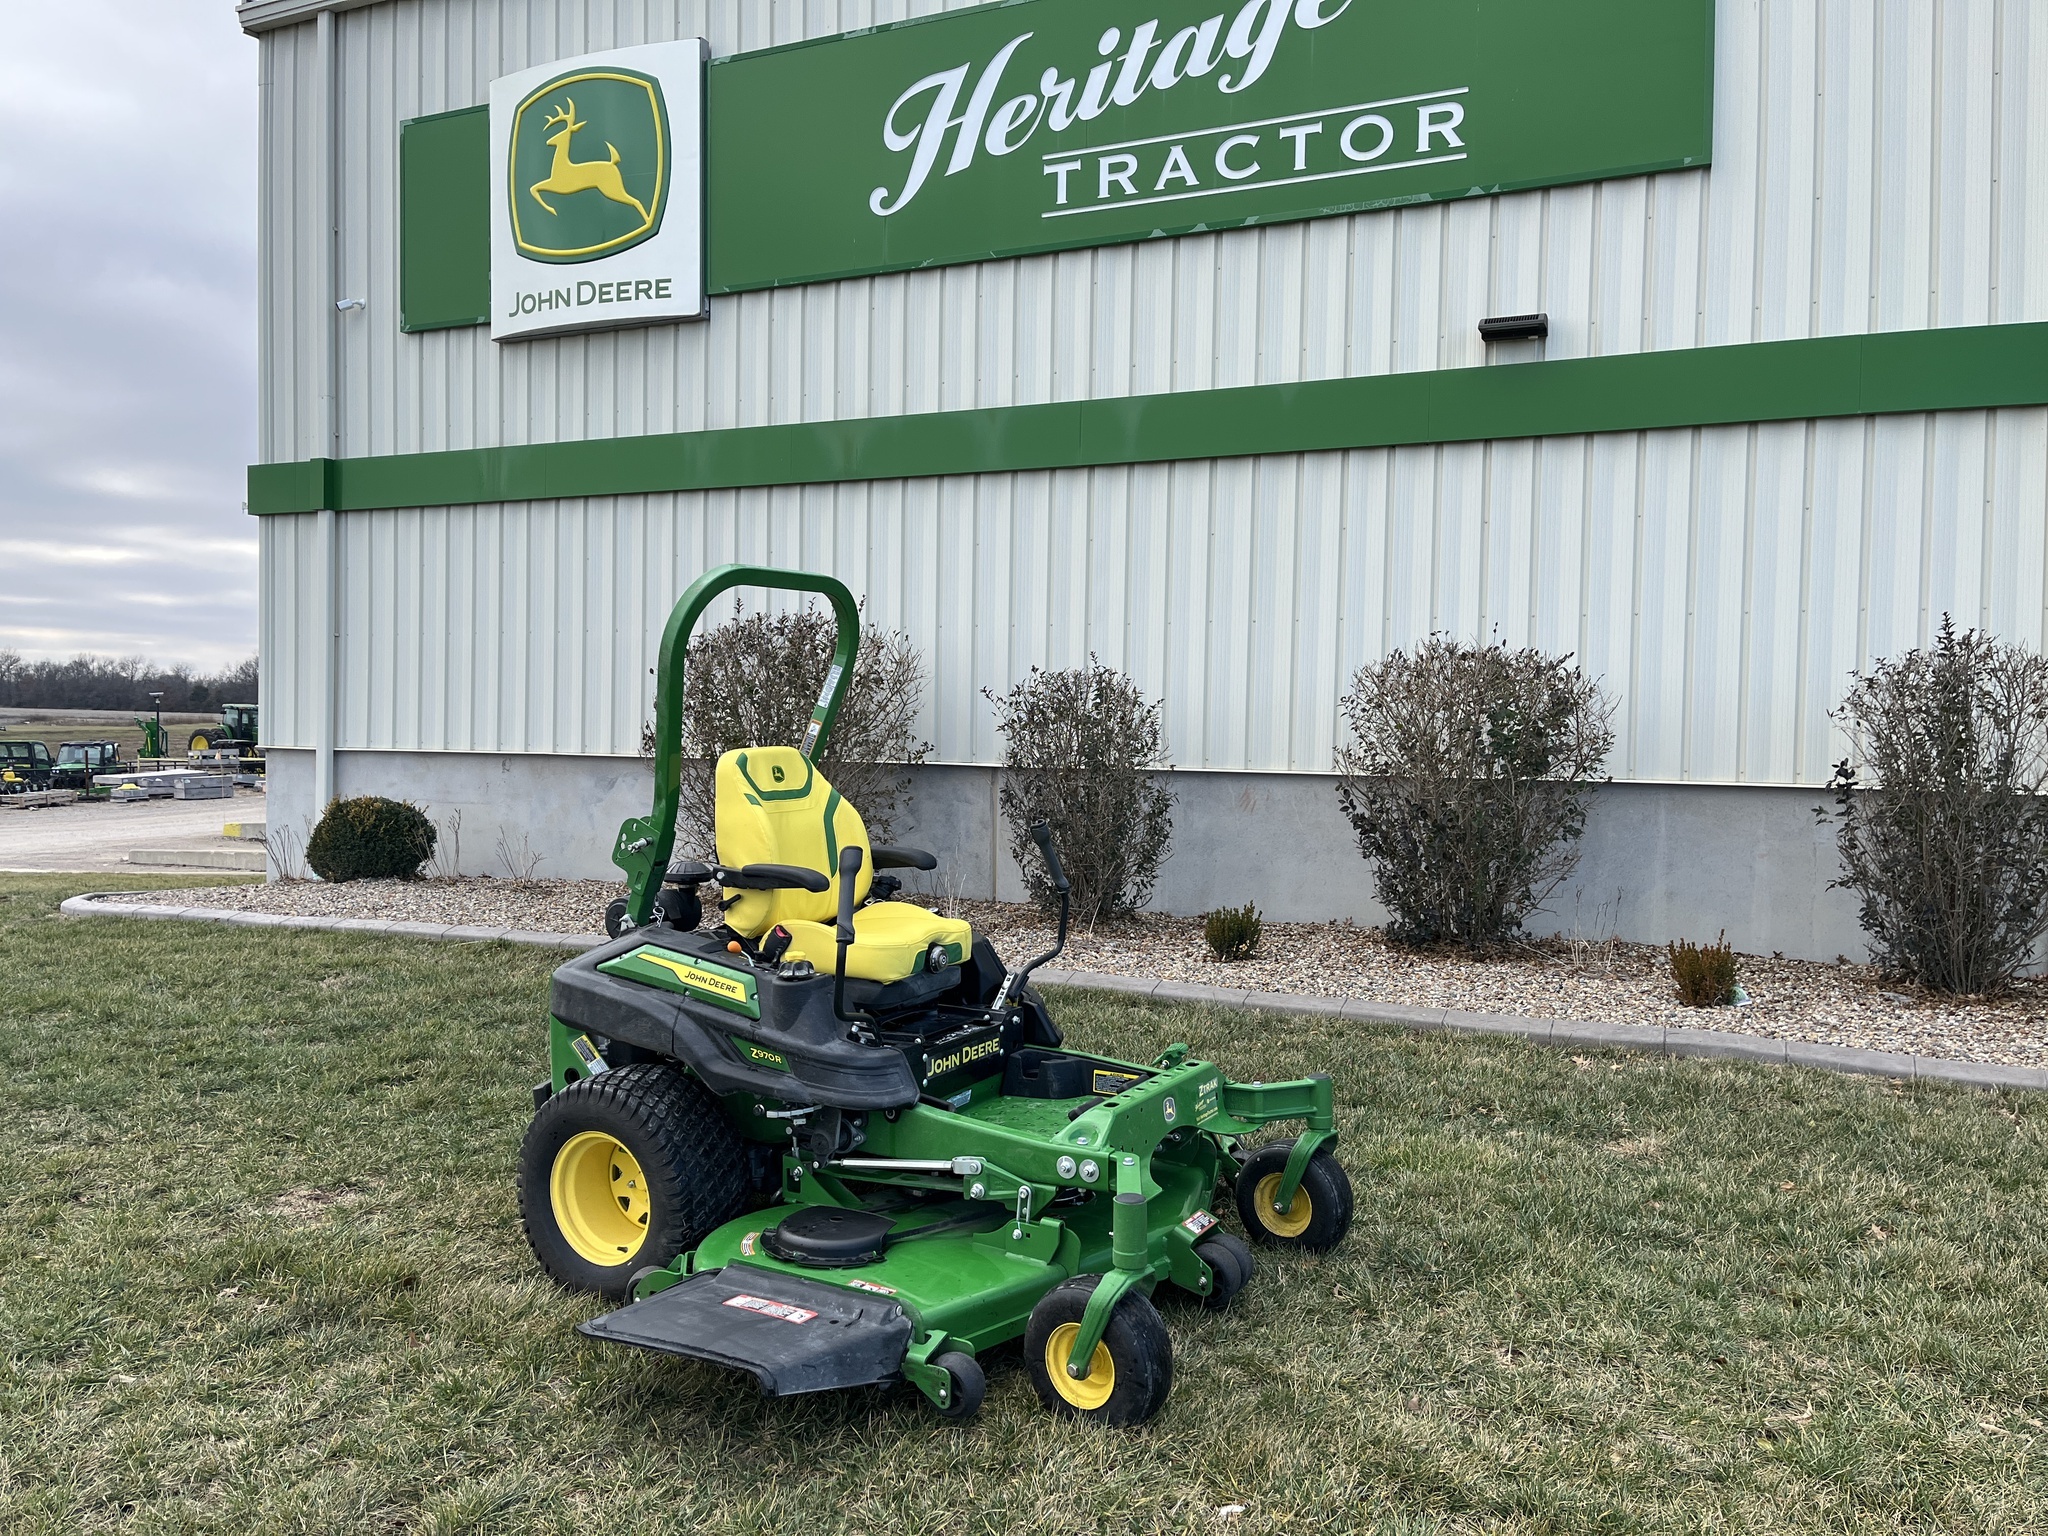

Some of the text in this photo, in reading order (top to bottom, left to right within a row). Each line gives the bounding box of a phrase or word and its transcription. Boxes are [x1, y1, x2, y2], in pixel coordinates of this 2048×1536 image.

[1042, 101, 1466, 205] TRACTOR
[508, 278, 672, 318] JOHN DEERE
[684, 971, 738, 994] JOHN DEERE
[750, 1047, 782, 1064] Z970R
[927, 1037, 1000, 1077] JOHN DEERE
